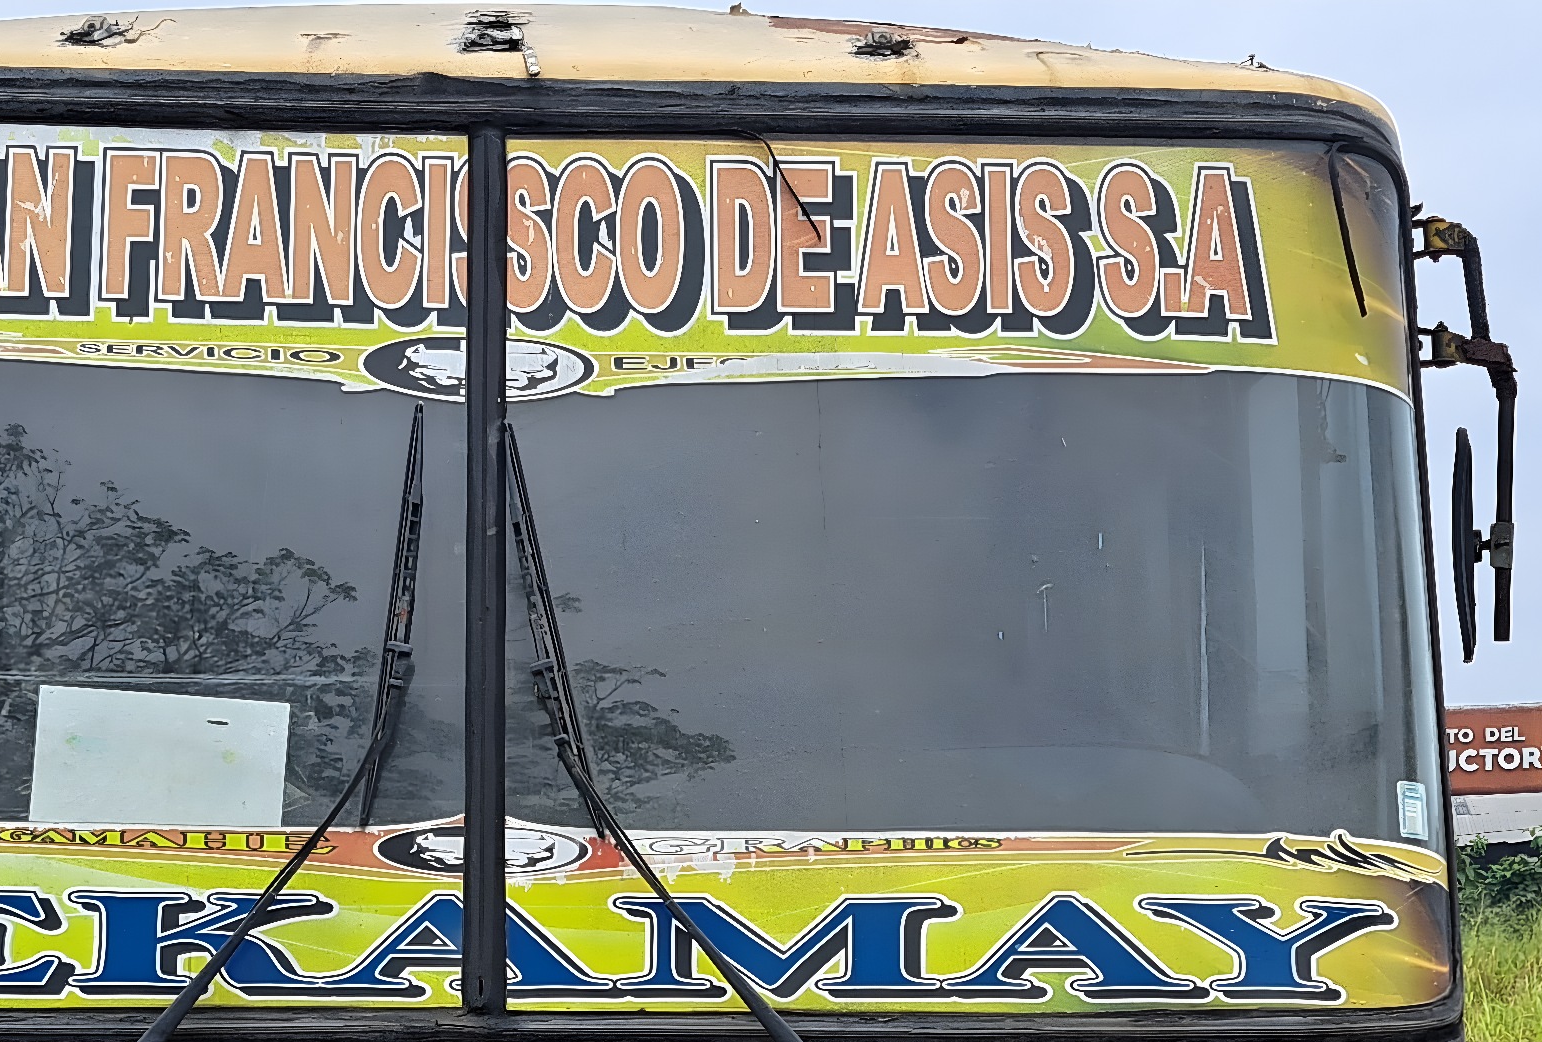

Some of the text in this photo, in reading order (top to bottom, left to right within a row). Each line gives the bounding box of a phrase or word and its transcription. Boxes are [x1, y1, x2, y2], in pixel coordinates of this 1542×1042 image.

[99, 147, 706, 337] FRANCISCO
[705, 154, 857, 336] DE
[859, 155, 1095, 339] ASIS
[1095, 157, 1277, 345] S.A
[78, 342, 342, 363] SERVICIO
[1484, 726, 1526, 742] DEL
